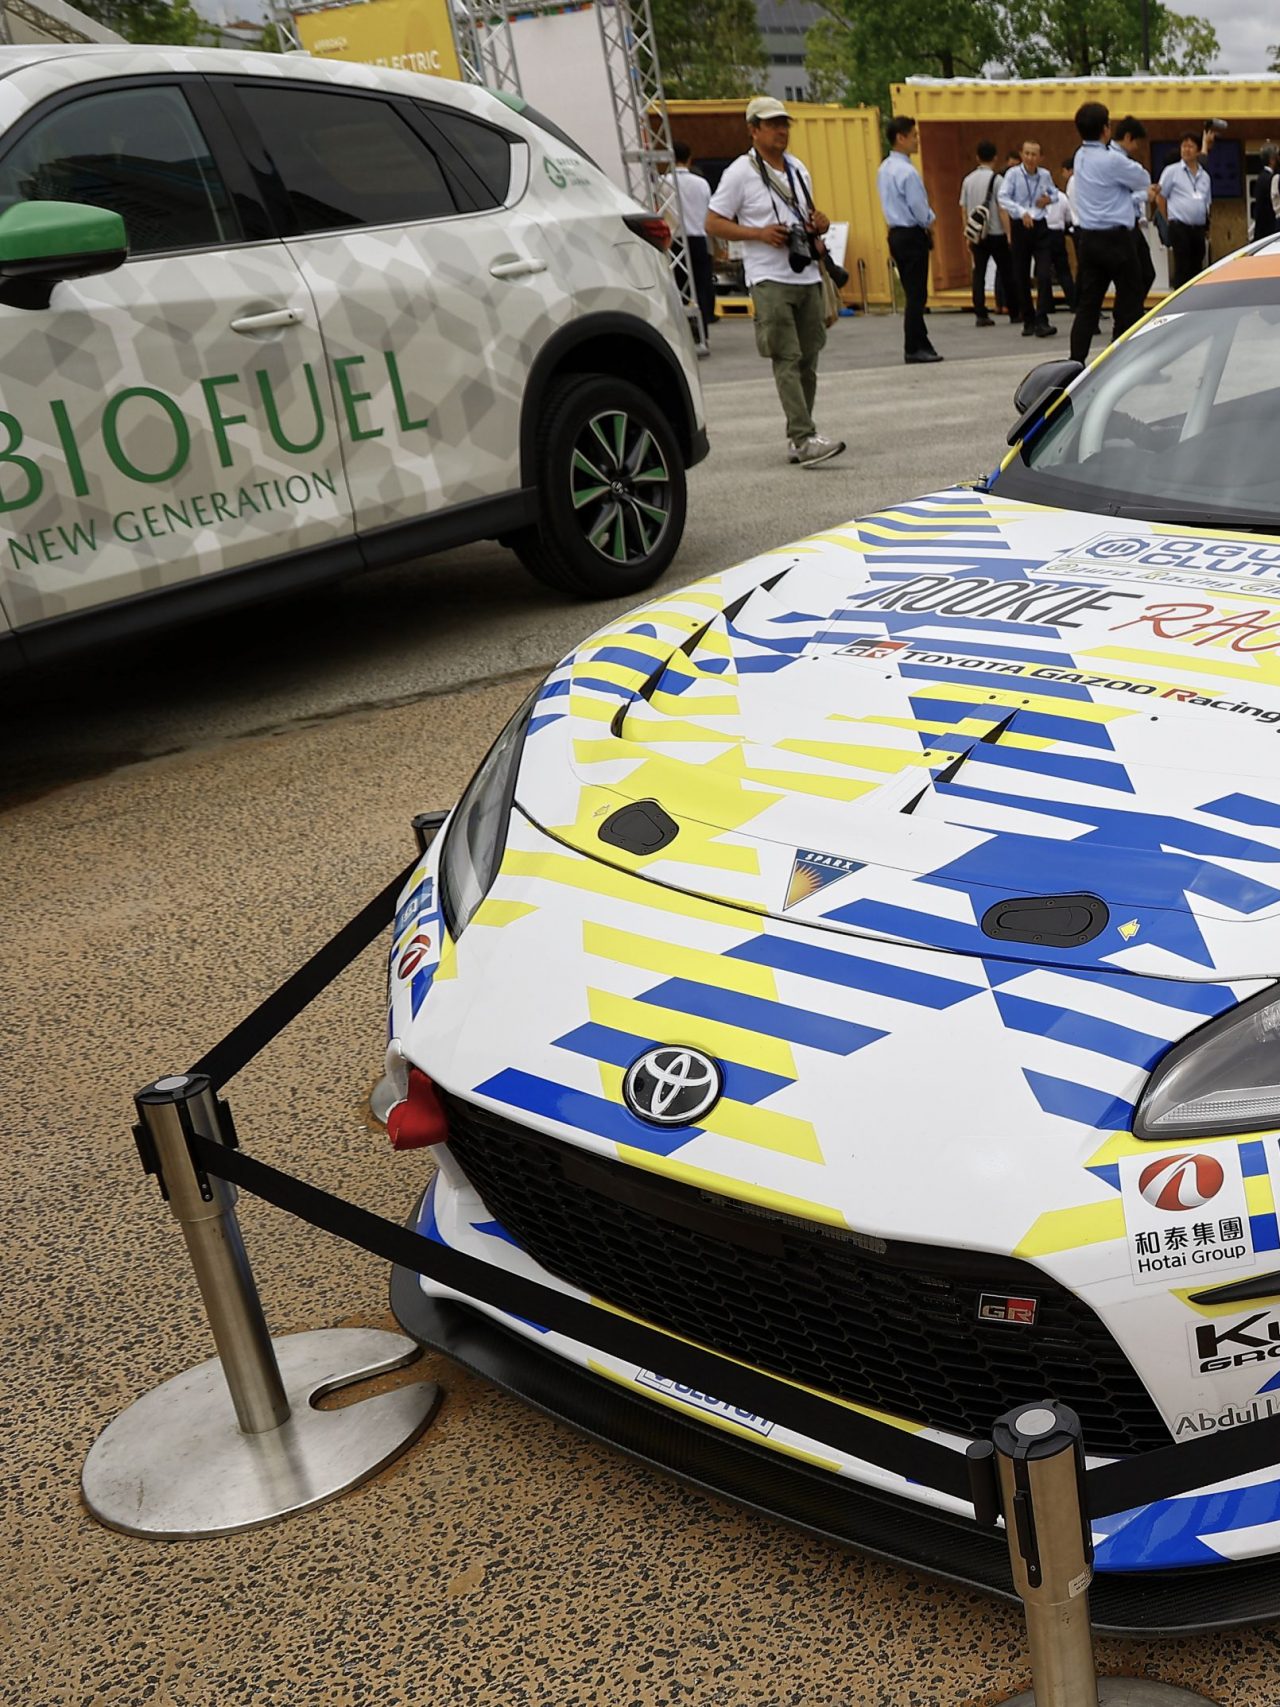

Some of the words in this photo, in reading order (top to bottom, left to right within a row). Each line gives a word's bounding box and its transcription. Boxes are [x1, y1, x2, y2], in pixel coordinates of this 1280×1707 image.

[0, 350, 430, 514] BIOFUEL
[7, 518, 98, 570] NEW
[112, 468, 338, 543] GENERATION
[1143, 570, 1235, 590] Racing
[857, 576, 1145, 628] ROOKIE
[842, 645, 889, 658] GR
[901, 650, 1027, 675] TOYOTA
[1030, 667, 1158, 695] GAZOO
[804, 853, 854, 870] SPARX
[1135, 1216, 1244, 1256] 和泰集團
[1138, 1252, 1187, 1273] Hotai
[1191, 1245, 1246, 1264] Group
[981, 1305, 1032, 1321] GR
[1175, 1401, 1259, 1436] Abdul
